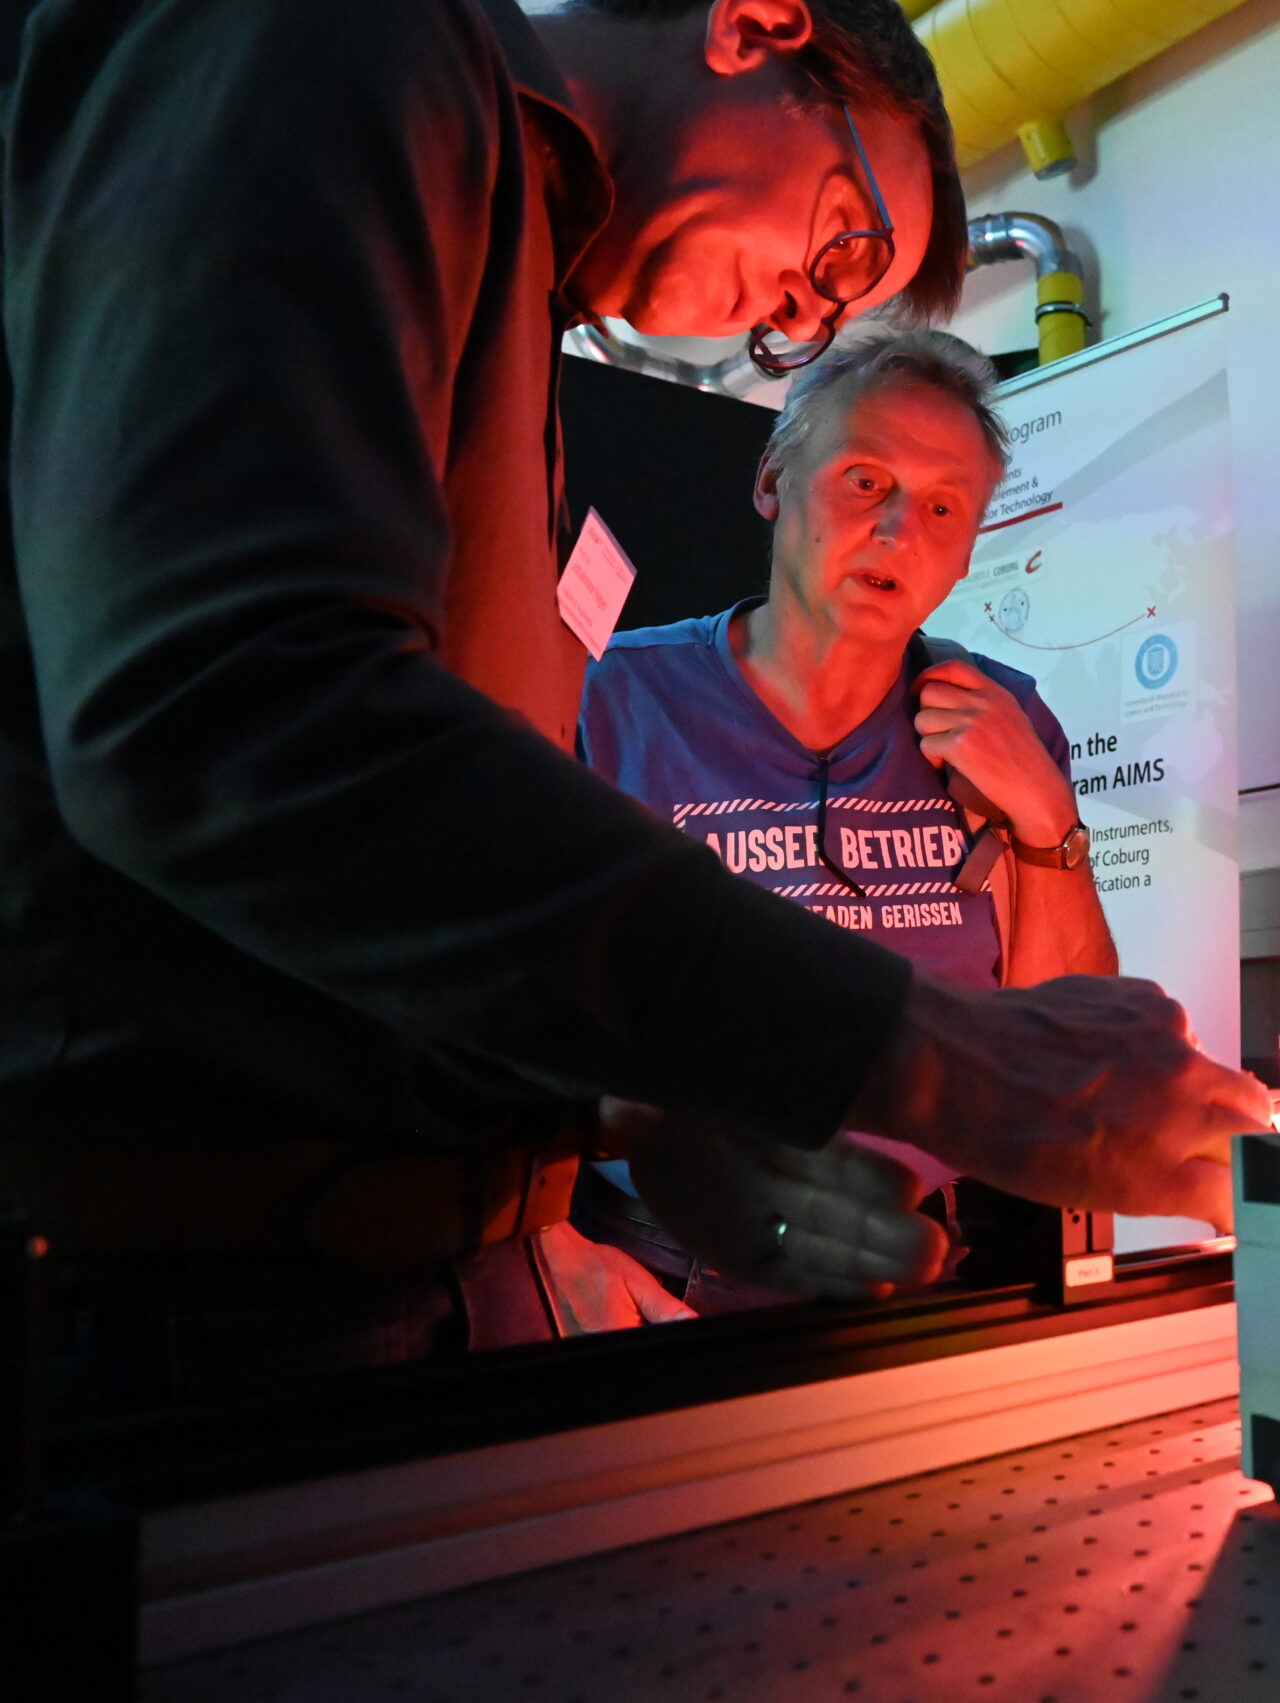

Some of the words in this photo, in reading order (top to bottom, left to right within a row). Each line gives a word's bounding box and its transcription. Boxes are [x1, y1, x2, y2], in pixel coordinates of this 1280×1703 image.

[1007, 468, 1021, 480] nts
[1032, 476, 1039, 488] &
[1001, 491, 1053, 515] Technology
[1071, 743, 1081, 760] n
[1087, 732, 1117, 757] the
[1073, 775, 1107, 796] ram
[1112, 758, 1165, 789] AIMS
[1092, 819, 1174, 843] Instruments,
[1102, 848, 1150, 868] Coburg
[1094, 874, 1140, 893] fication
[882, 902, 963, 929] GERISSEN
